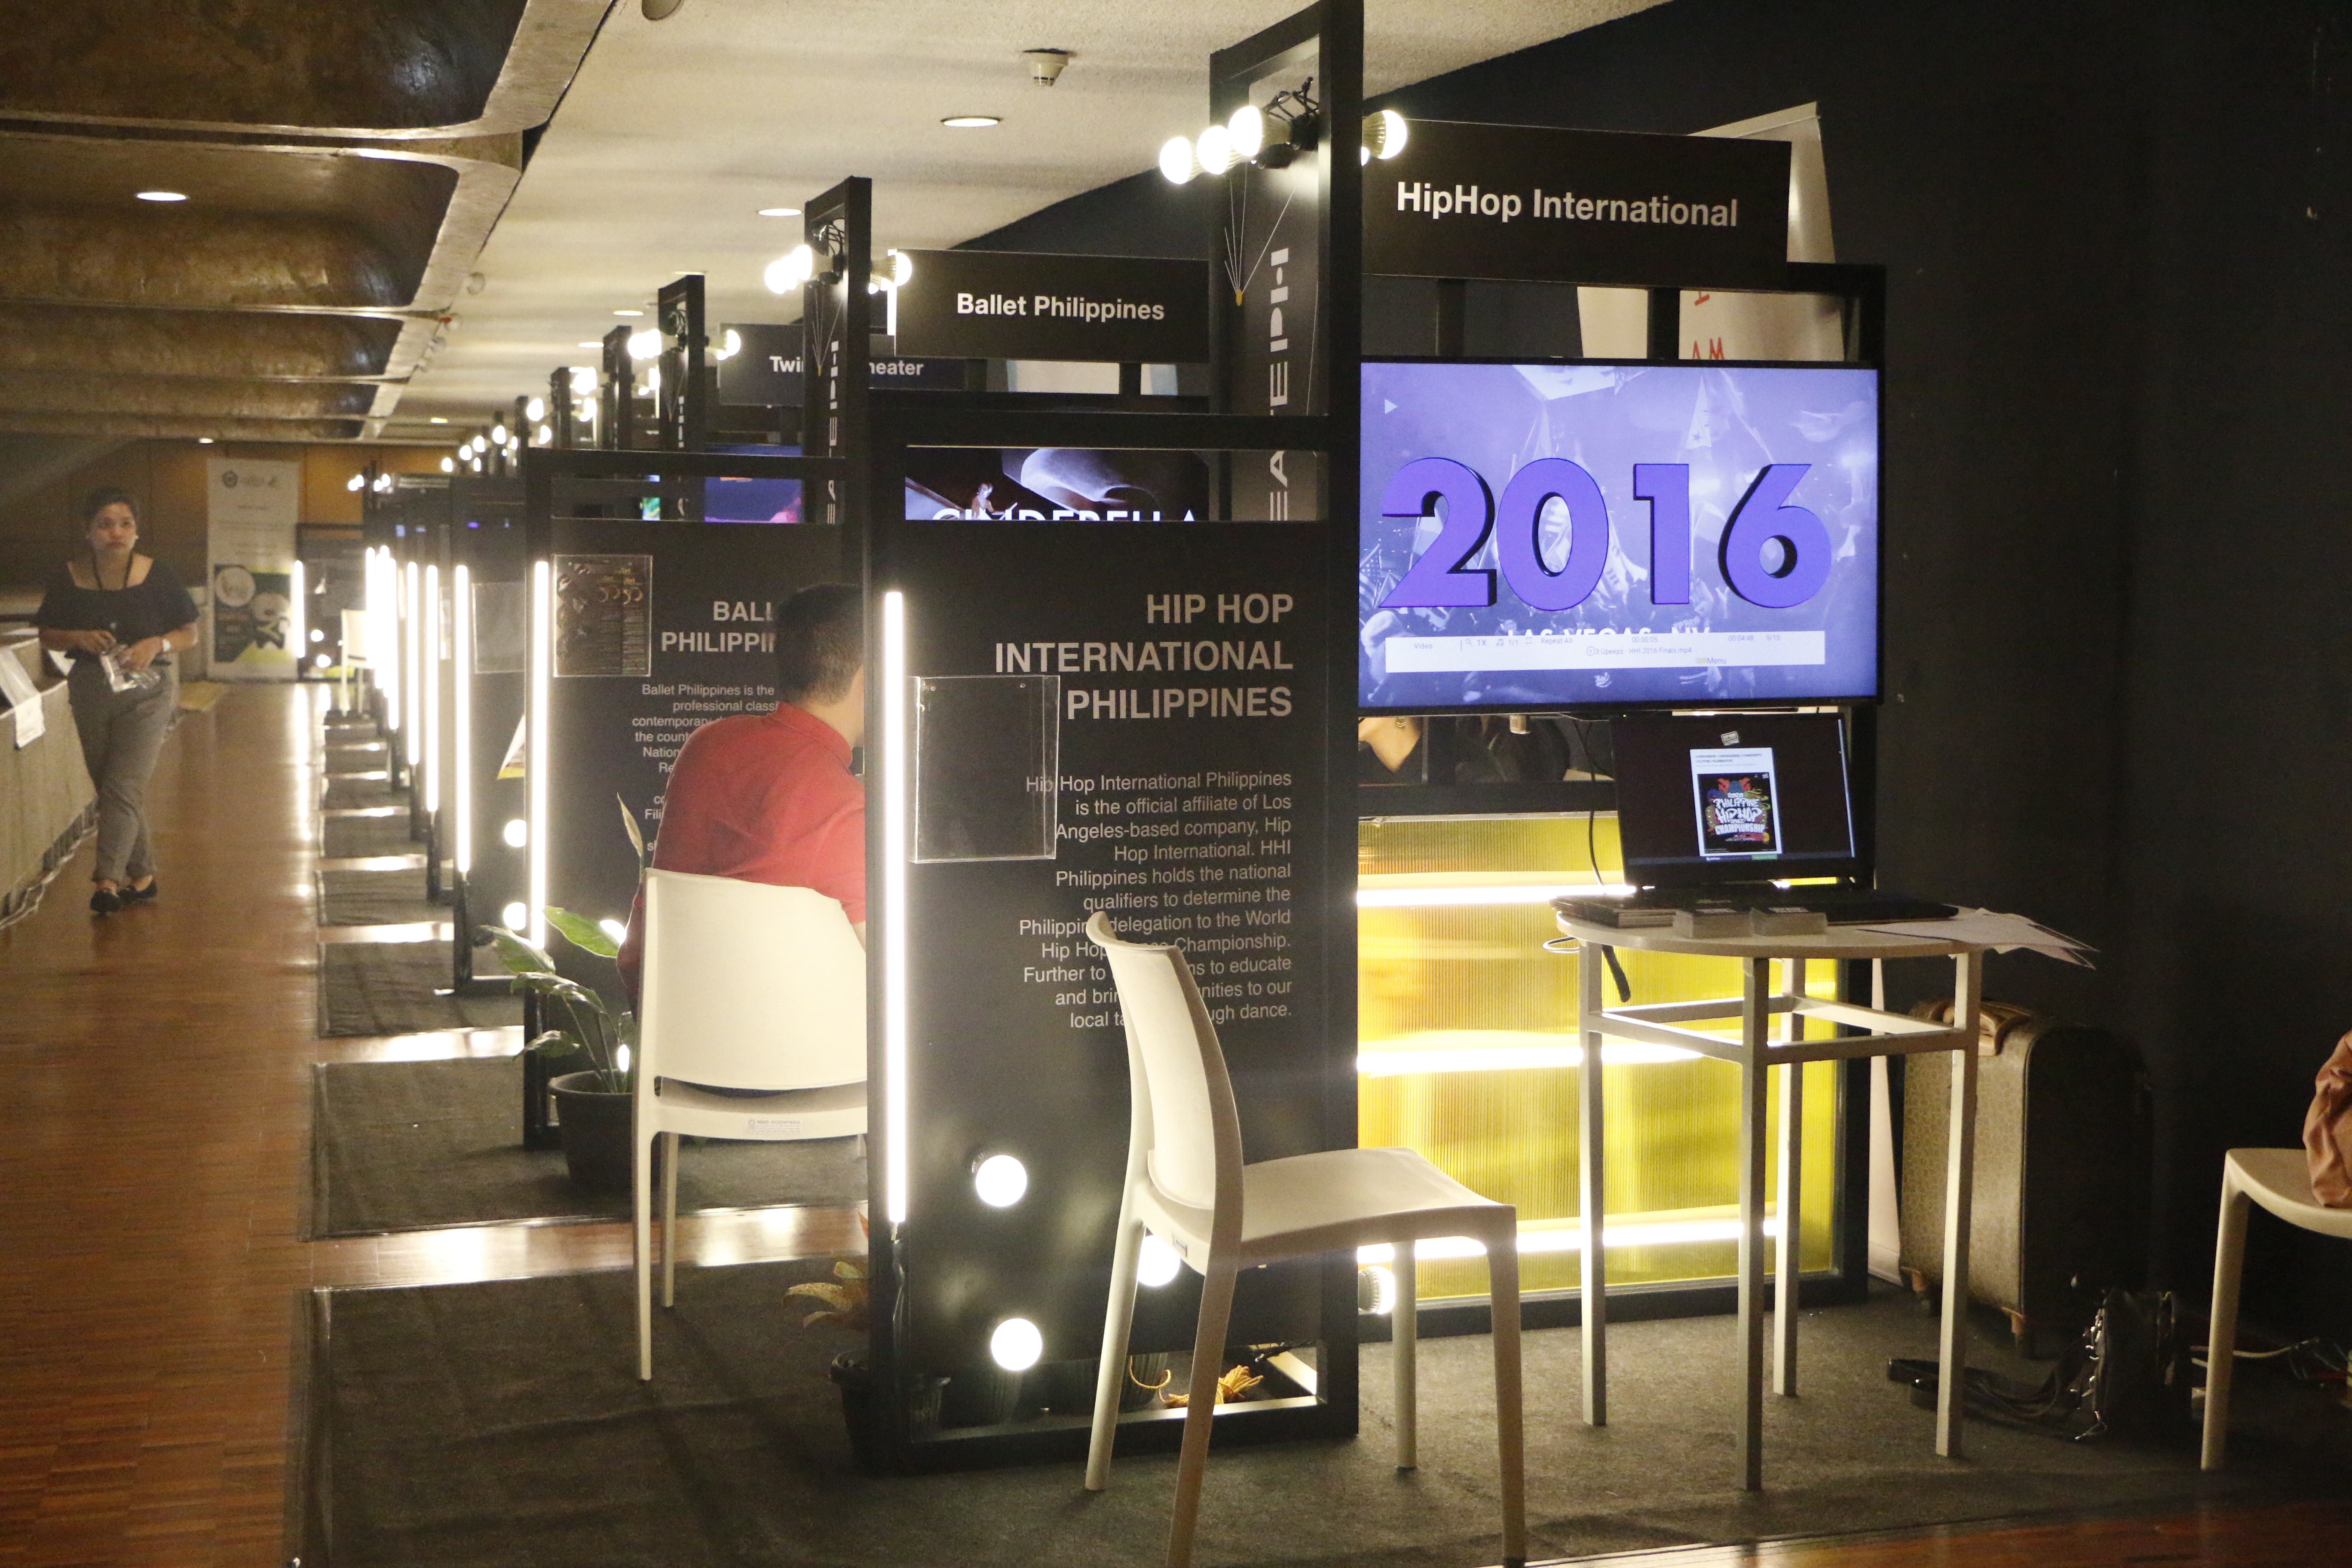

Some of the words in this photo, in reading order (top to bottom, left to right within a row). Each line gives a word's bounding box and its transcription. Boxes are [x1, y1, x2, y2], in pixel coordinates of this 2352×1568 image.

[1397, 181, 1522, 223] HipHop
[1534, 187, 1738, 227] International
[957, 292, 1026, 317] Ballet
[1033, 295, 1164, 323] Philippines
[769, 355, 804, 373] Twi
[1378, 456, 1832, 612] 2016
[1147, 593, 1205, 624] HIP
[1217, 593, 1293, 624] HOP
[995, 640, 1293, 673] INTERNATIONAL
[642, 684, 675, 695] Ballet
[678, 683, 740, 697] Philippines
[744, 685, 753, 695] is
[756, 685, 775, 695] the
[1066, 687, 1292, 720] PHILIPPINES
[673, 700, 742, 713] professional
[634, 732, 653, 742] the
[1060, 775, 1095, 795] Hop
[1101, 772, 1200, 791] International
[1206, 771, 1291, 790] Philippines
[1075, 799, 1090, 815] is
[1094, 799, 1121, 815] the
[1126, 796, 1177, 814] official
[1182, 795, 1238, 812] affiliate
[1242, 794, 1258, 810] of
[1263, 793, 1291, 810] Los
[1713, 798, 1760, 809] PHILIPPINE
[1056, 820, 1179, 843] Angeles-based
[1184, 821, 1259, 838] company,
[1265, 816, 1291, 836] Hip
[1714, 823, 1766, 836] CHAMPIONSHIP
[1114, 845, 1148, 865] Hop
[1154, 841, 1254, 860] International.
[1260, 839, 1291, 855] HHI
[1056, 869, 1147, 890] Philippines
[1152, 867, 1195, 884] holds
[1199, 865, 1224, 882] the
[1229, 862, 1291, 880] national
[1083, 892, 1158, 914] qualifiers
[1163, 892, 1178, 907] to
[1183, 888, 1261, 906] determine
[1265, 885, 1291, 902] the
[1110, 914, 1191, 935] delegation
[1196, 913, 1212, 929] to
[1216, 912, 1241, 928] the
[1245, 908, 1291, 925] World
[1041, 942, 1070, 962] Hip
[1174, 932, 1291, 954] Championship.
[1023, 965, 1085, 983] Further
[1090, 965, 1106, 980] to
[1210, 959, 1225, 975] to
[1229, 956, 1292, 973] educate
[1055, 988, 1087, 1006] and
[1247, 980, 1262, 996] to
[1267, 980, 1292, 995] our
[1070, 1011, 1109, 1029] local
[1240, 1003, 1292, 1019] dance.
